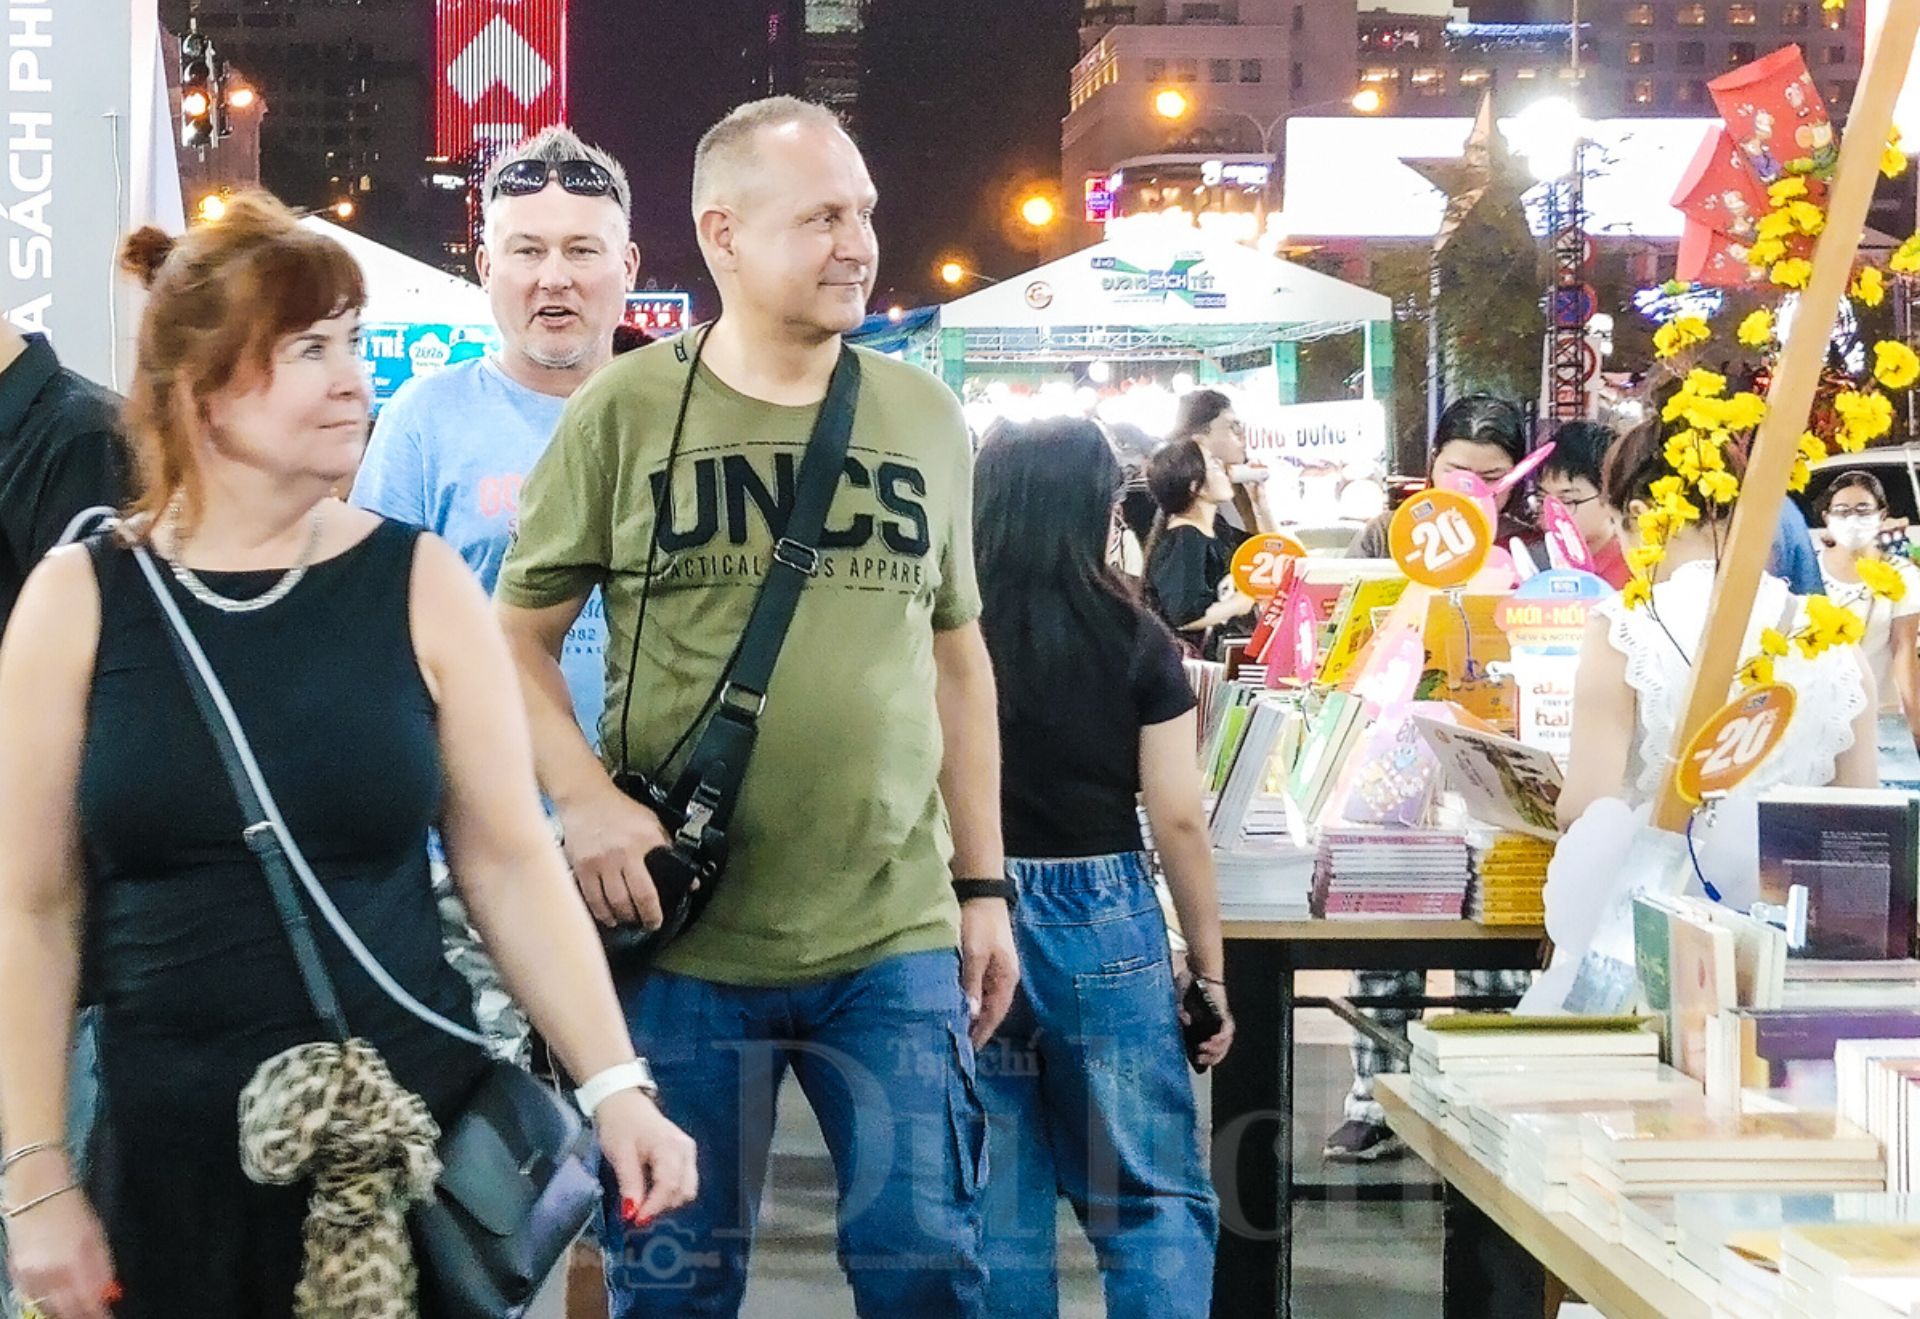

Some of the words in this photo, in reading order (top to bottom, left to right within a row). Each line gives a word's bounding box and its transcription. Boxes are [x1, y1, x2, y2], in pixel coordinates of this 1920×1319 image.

[9, 0, 52, 92] PH
[0, 112, 52, 280] SÁCH
[649, 453, 931, 557] UNCS
[663, 555, 763, 580] ACTICAL
[850, 559, 922, 585] APPARE
[567, 628, 596, 641] 982
